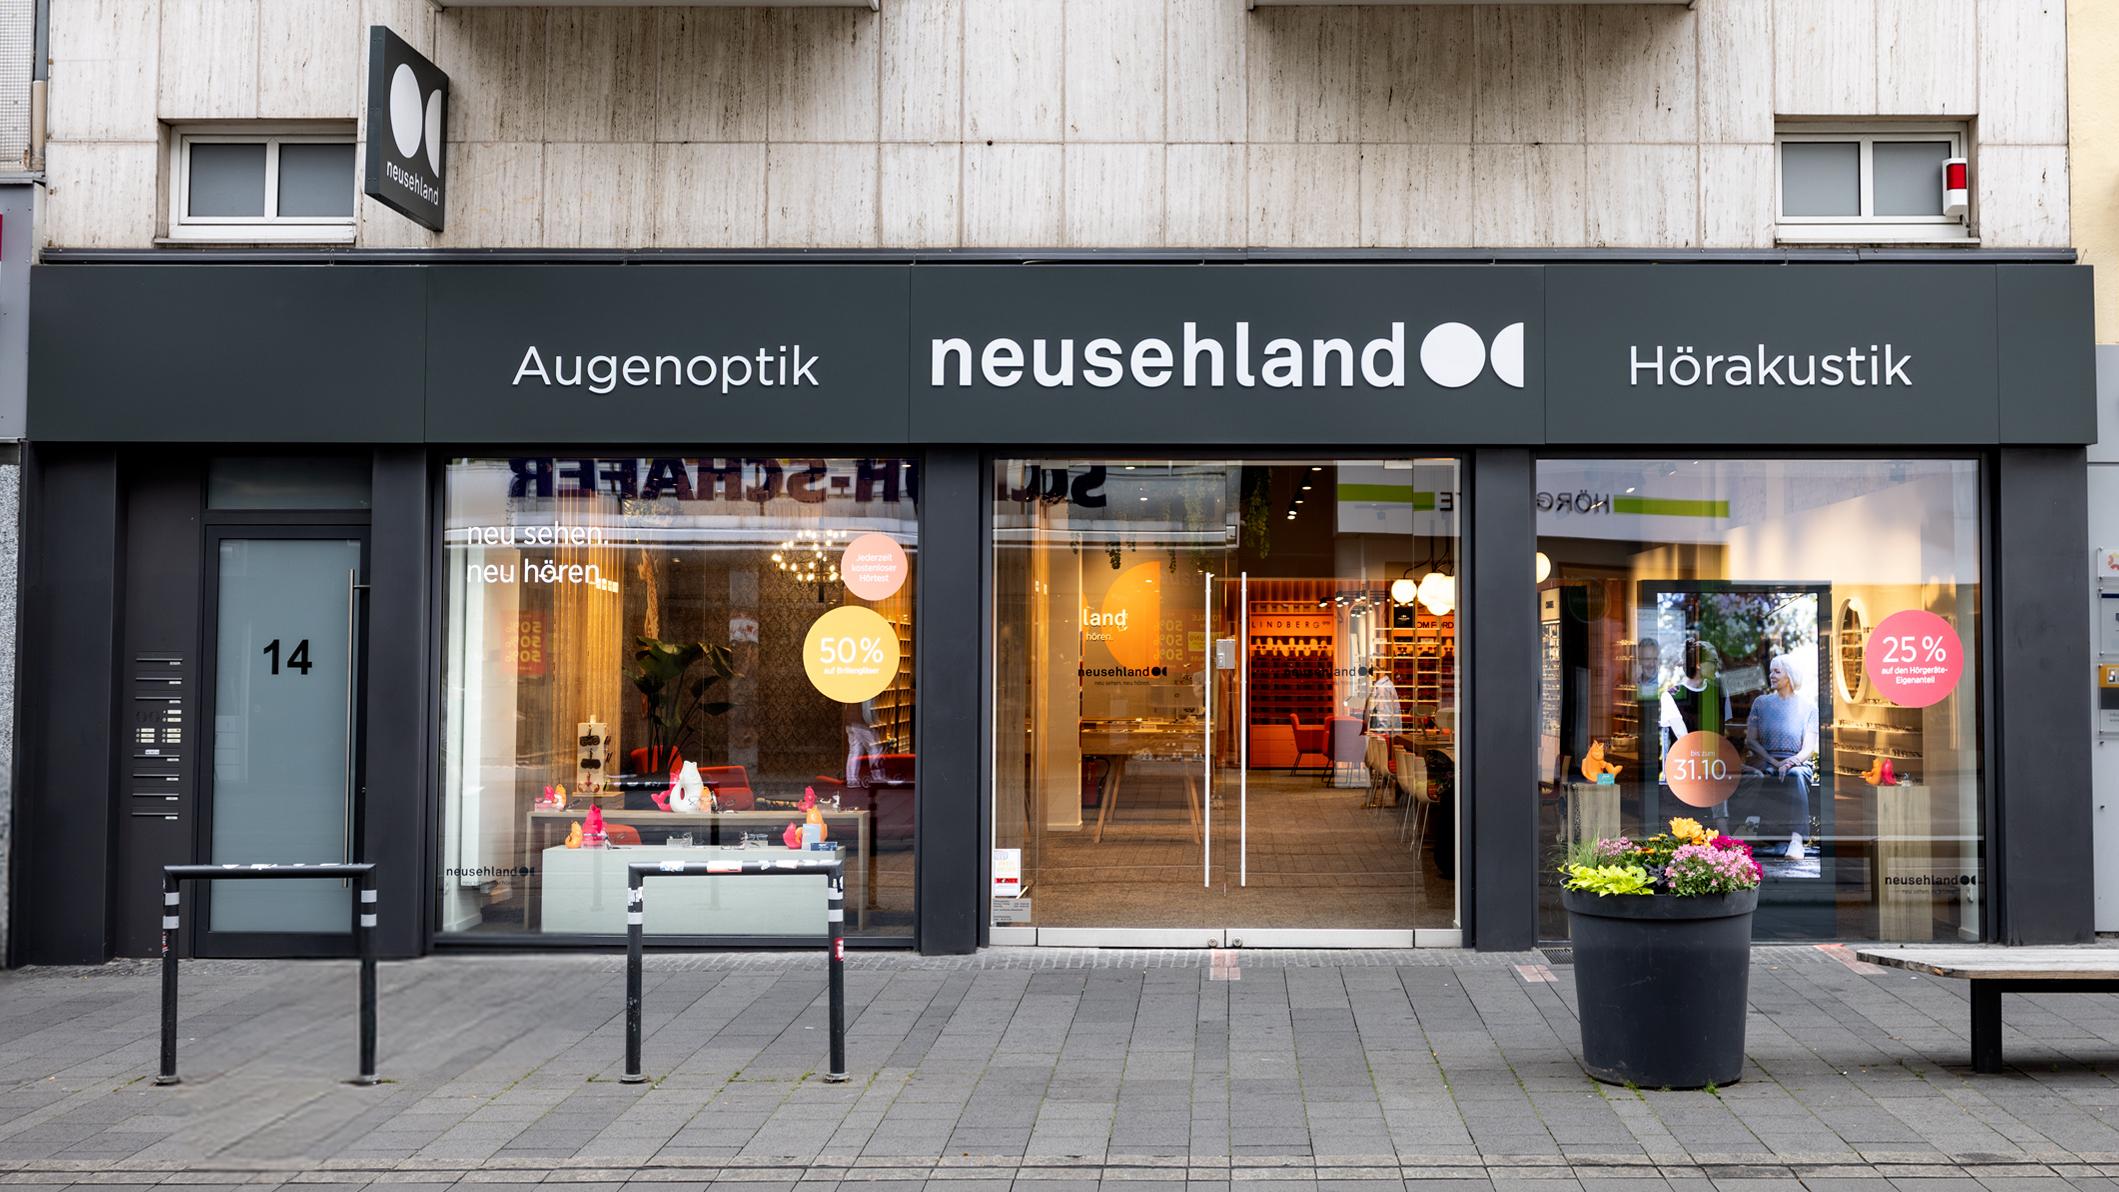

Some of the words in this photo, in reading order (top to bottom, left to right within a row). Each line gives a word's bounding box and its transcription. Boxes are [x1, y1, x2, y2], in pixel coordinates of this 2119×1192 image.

[386, 161, 439, 206] neusehland
[930, 321, 1405, 388] neusehland
[512, 344, 819, 394] Augenoptik
[1630, 343, 1913, 387] Hörakustik
[467, 526, 515, 545] neu
[524, 520, 609, 545] sehen.
[467, 563, 515, 583] neu
[1083, 608, 1127, 626] land
[1251, 620, 1319, 629] LINDBERG
[263, 639, 313, 675] 14
[1078, 666, 1150, 677] neusehland
[1881, 667, 1893, 675] auf
[1894, 667, 1908, 675] den
[1673, 759, 1732, 780] 31.10.
[446, 866, 517, 877] neusehland
[1885, 875, 1958, 886] neusehland
